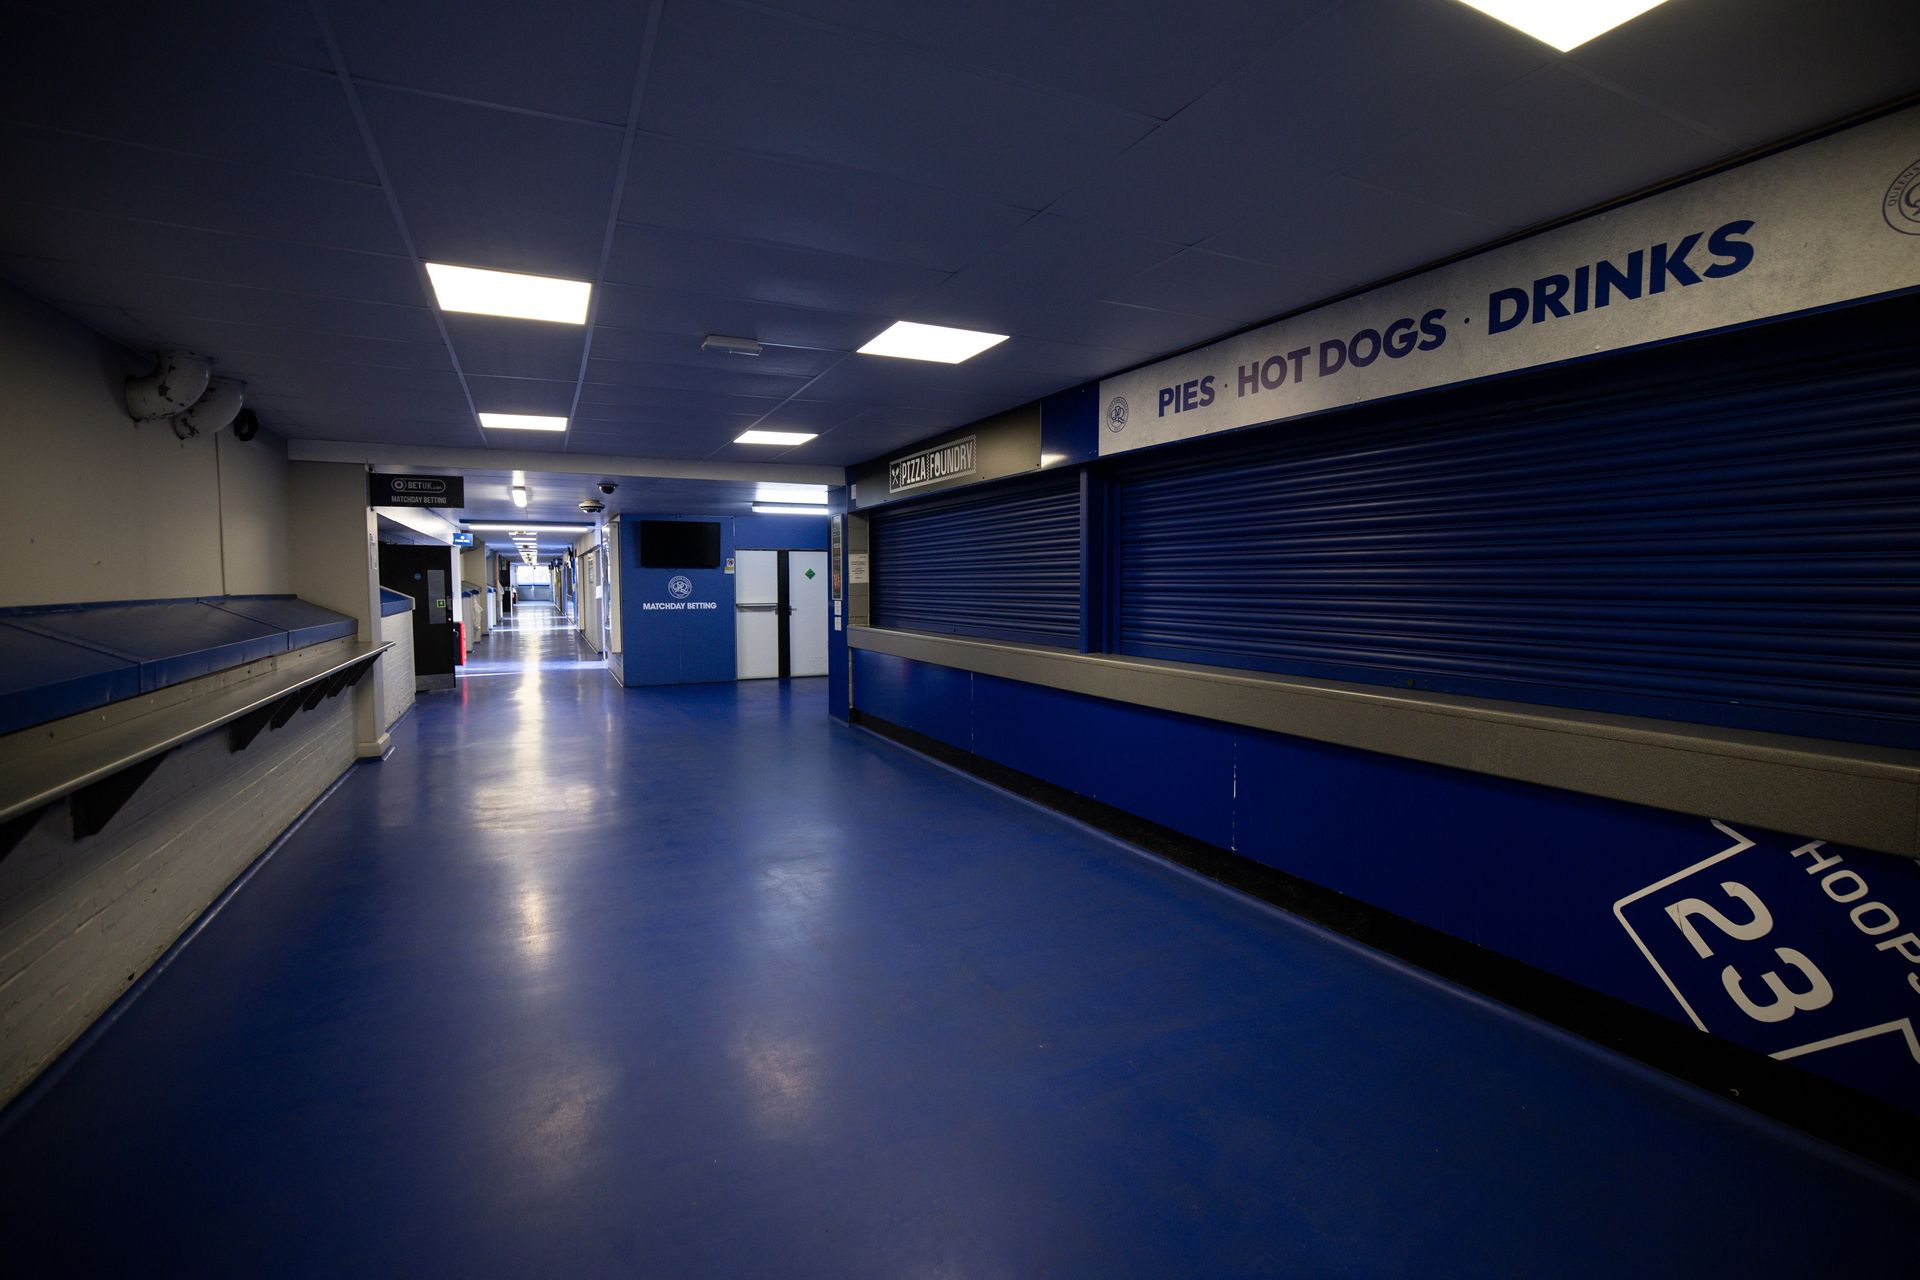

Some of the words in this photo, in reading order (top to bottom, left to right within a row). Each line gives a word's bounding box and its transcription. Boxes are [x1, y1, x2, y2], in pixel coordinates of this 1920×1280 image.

[1158, 374, 1216, 419] PIES
[1238, 345, 1311, 397] HOT
[1319, 308, 1448, 377] DOGS
[1487, 219, 1757, 336] DRINKS
[391, 496, 422, 504] MATCHDAY
[901, 456, 926, 485] PIZZA
[930, 442, 973, 478] FOUNDRY
[642, 602, 685, 611] MATCHDAY
[687, 601, 718, 610] BETTING
[1663, 880, 1835, 1024] 23
[1790, 839, 1920, 997] HOOP
